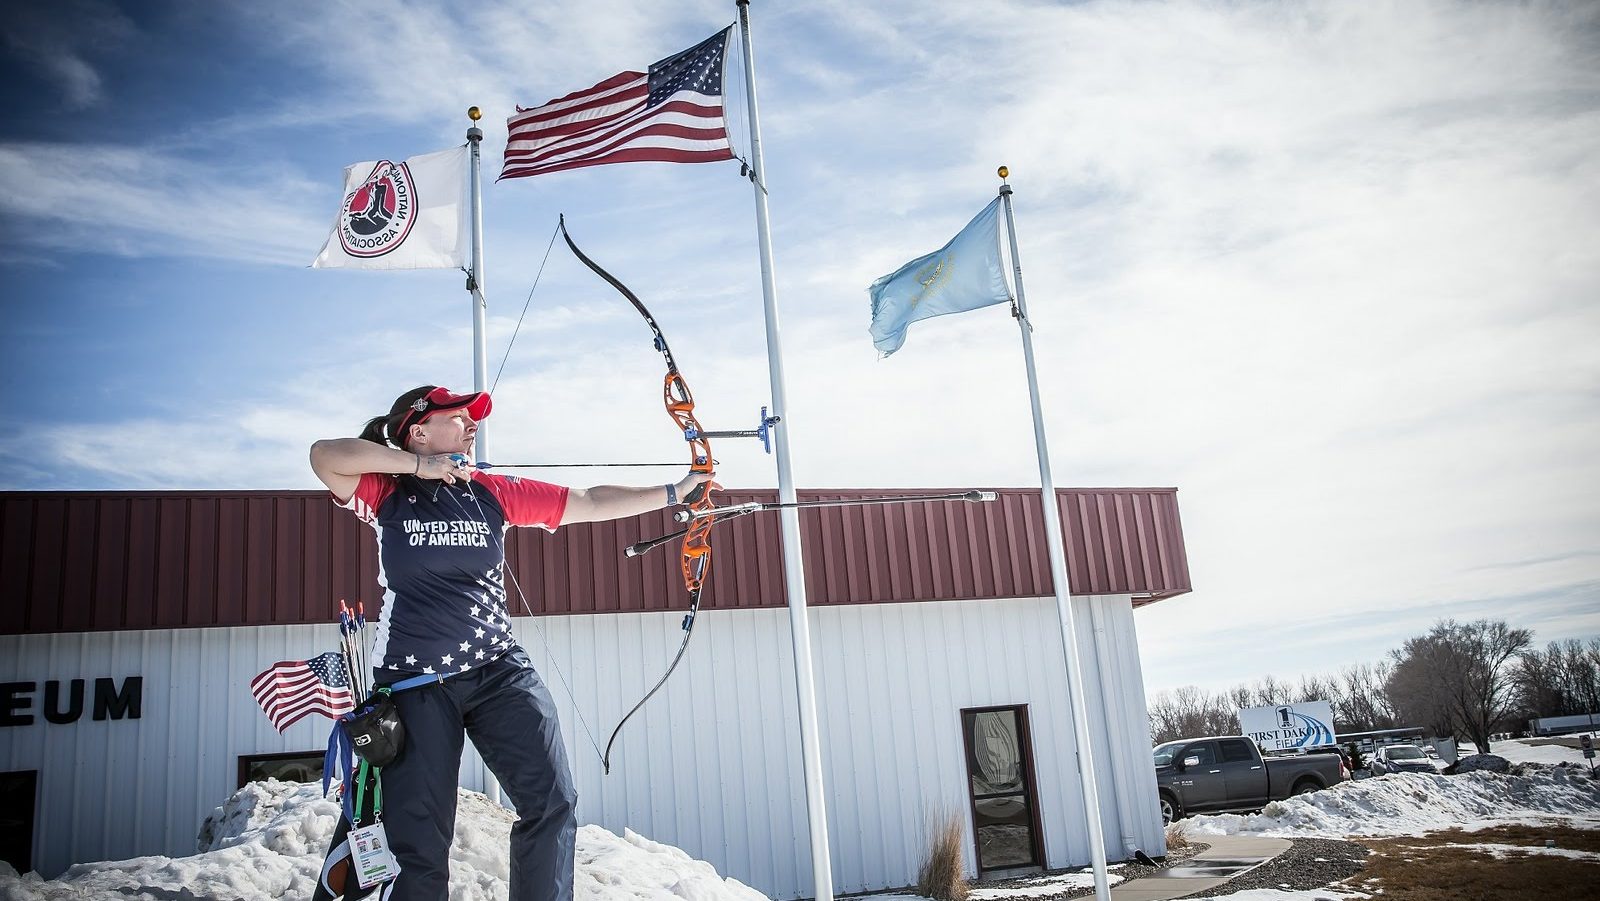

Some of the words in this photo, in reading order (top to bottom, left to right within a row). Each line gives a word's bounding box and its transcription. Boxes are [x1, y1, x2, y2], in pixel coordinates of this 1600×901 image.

[403, 519, 448, 533] UNITED
[449, 520, 490, 535] STATES
[409, 532, 426, 546] OF
[428, 533, 488, 548] AMERICA
[0, 676, 143, 727] EUM
[1248, 730, 1279, 741] FIRST
[1276, 738, 1303, 749] FIELD
